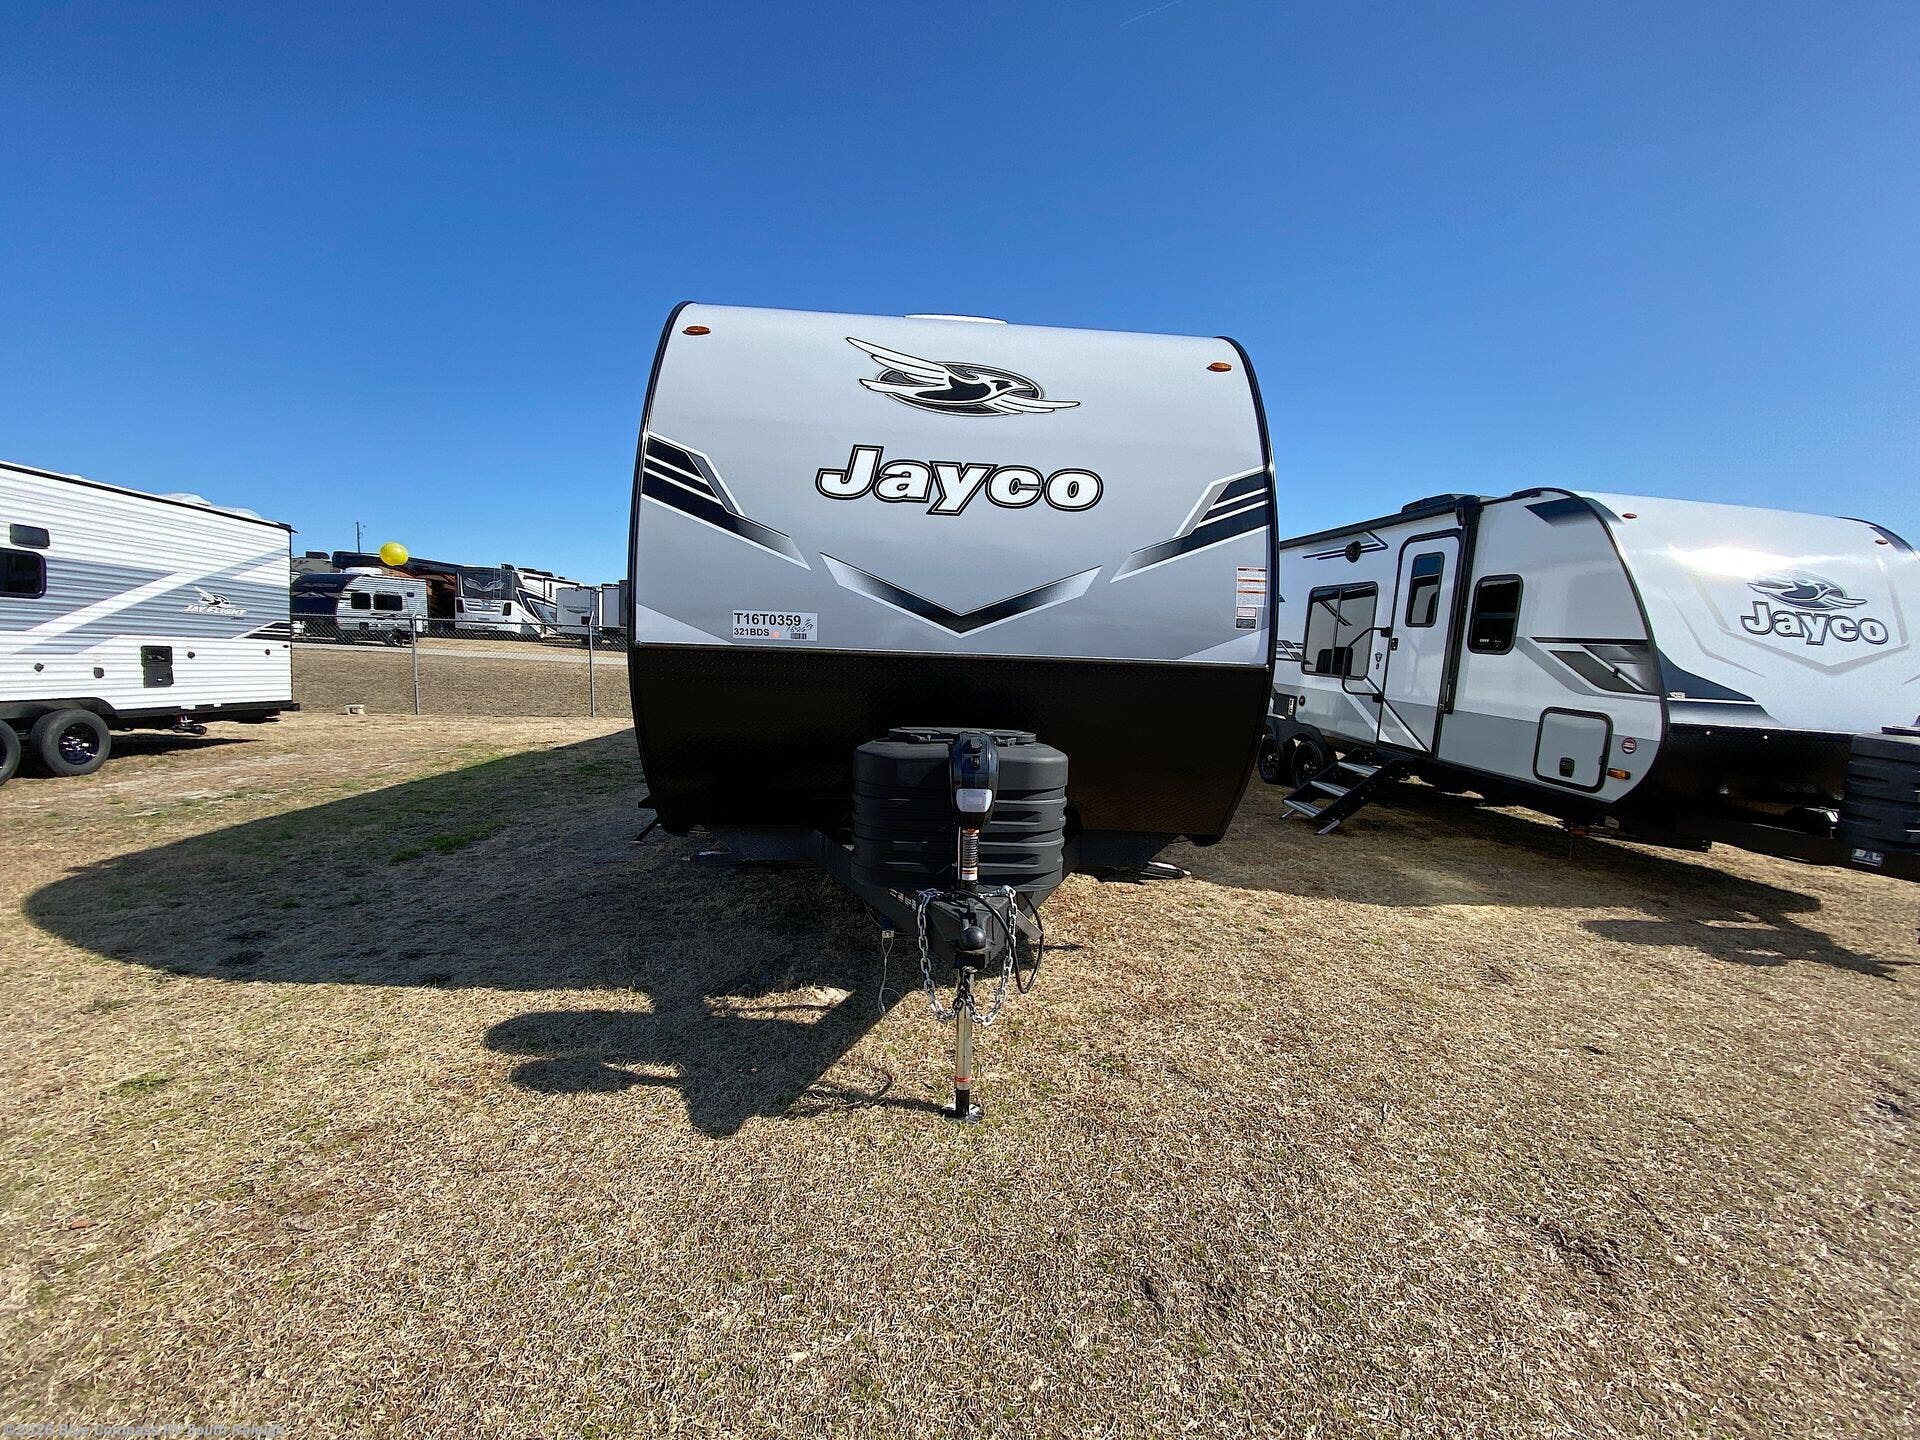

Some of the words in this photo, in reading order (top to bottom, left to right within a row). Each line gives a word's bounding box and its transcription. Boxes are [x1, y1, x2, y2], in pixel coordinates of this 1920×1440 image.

[815, 444, 1104, 516] Jayco
[183, 604, 206, 613] JAY
[206, 605, 248, 616] FLIGHT
[734, 613, 801, 626] T16T0359
[1740, 601, 1889, 645] Jayco
[734, 627, 770, 636] 321BDS
